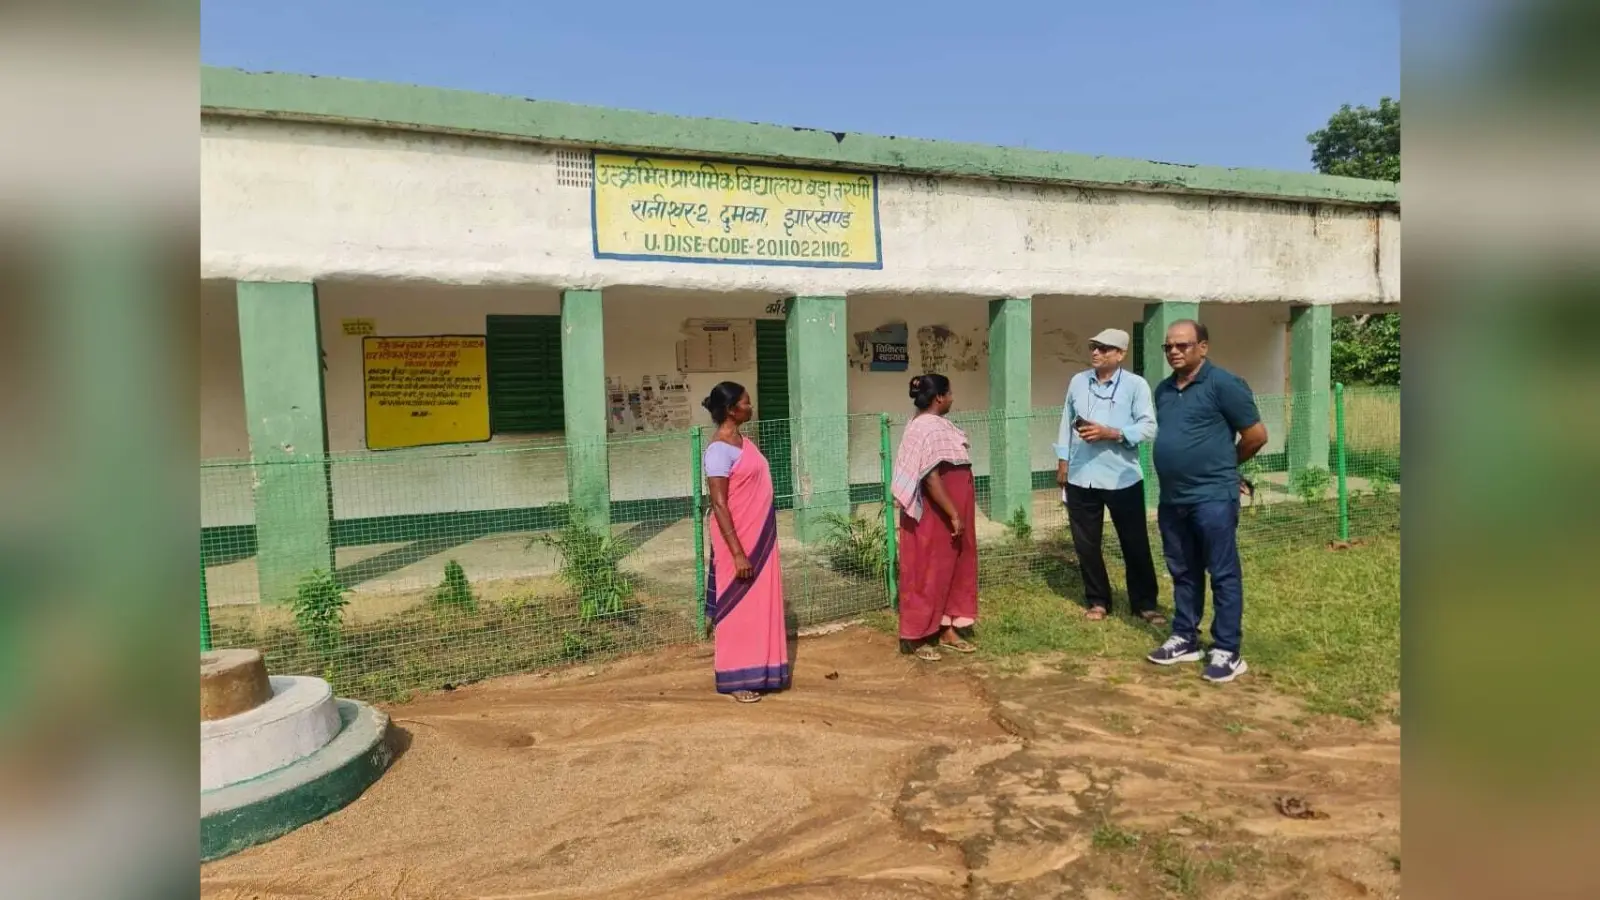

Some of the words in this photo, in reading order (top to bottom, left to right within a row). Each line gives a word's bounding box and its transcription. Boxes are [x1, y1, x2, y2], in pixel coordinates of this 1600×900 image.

[671, 163, 734, 191] प्राथमिक
[735, 166, 802, 204] विद्यालय
[784, 209, 853, 236] झारखण्ड
